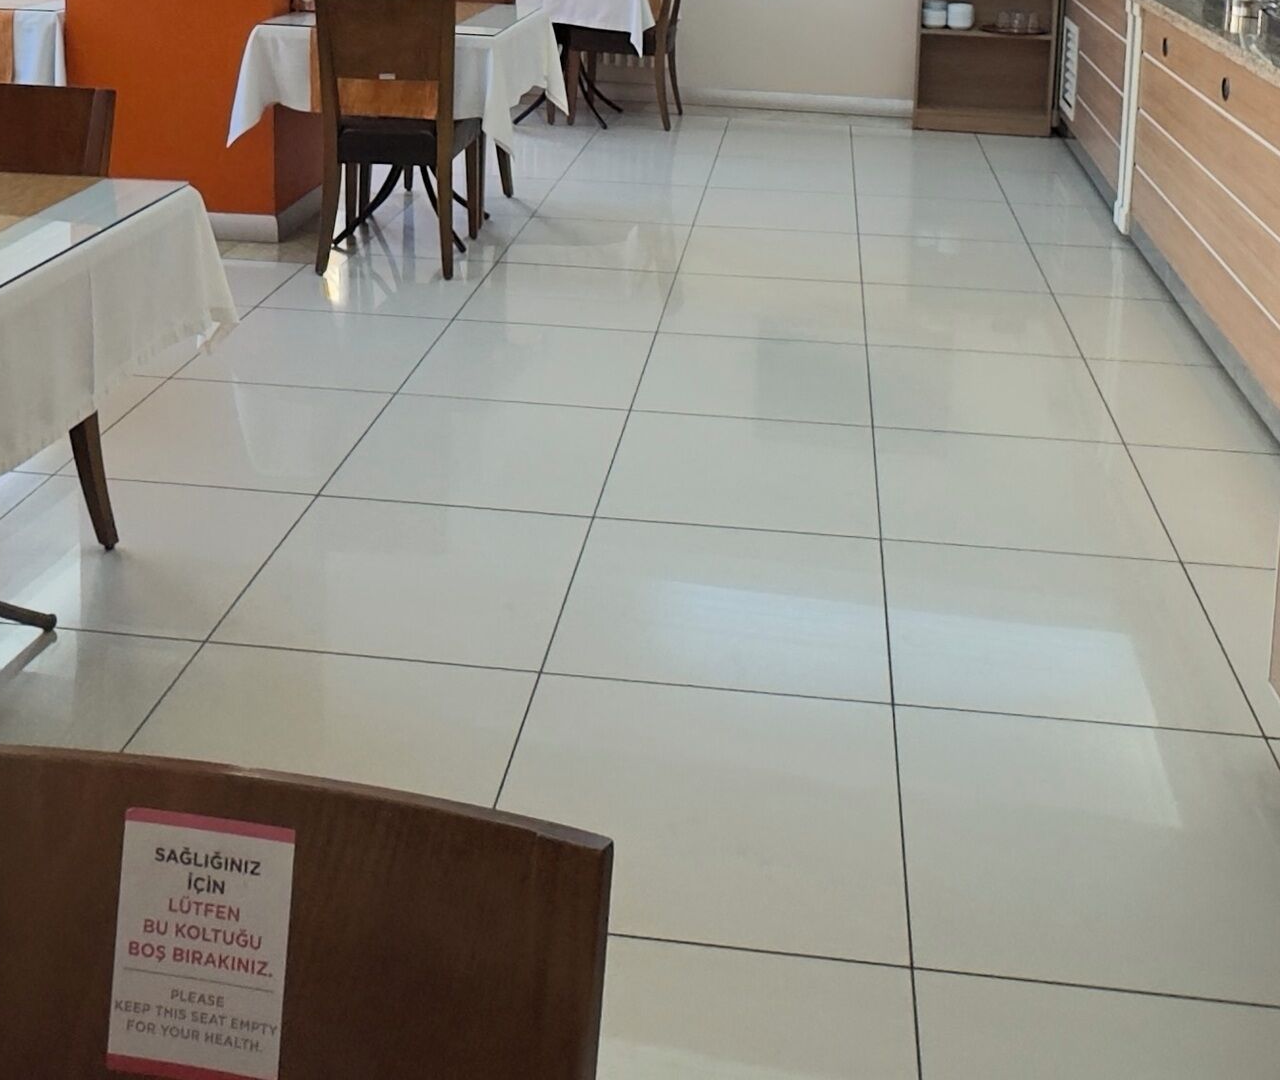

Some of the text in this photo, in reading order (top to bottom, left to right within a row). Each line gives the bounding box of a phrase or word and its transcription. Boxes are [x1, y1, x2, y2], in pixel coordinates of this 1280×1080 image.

[154, 846, 262, 876] SAĞLIĞINIZ
[187, 872, 226, 895] İÇİN
[168, 896, 241, 922] LÜTFEN
[143, 919, 262, 951] BU KOLTUĞU
[128, 941, 273, 978] BOŞ BIRAKINIZ.
[170, 988, 225, 1008] PLEASE
[114, 999, 278, 1037] KEEP THIS SEAT EMPTY
[126, 1019, 156, 1034] FOR
[160, 1025, 200, 1041] YOUR
